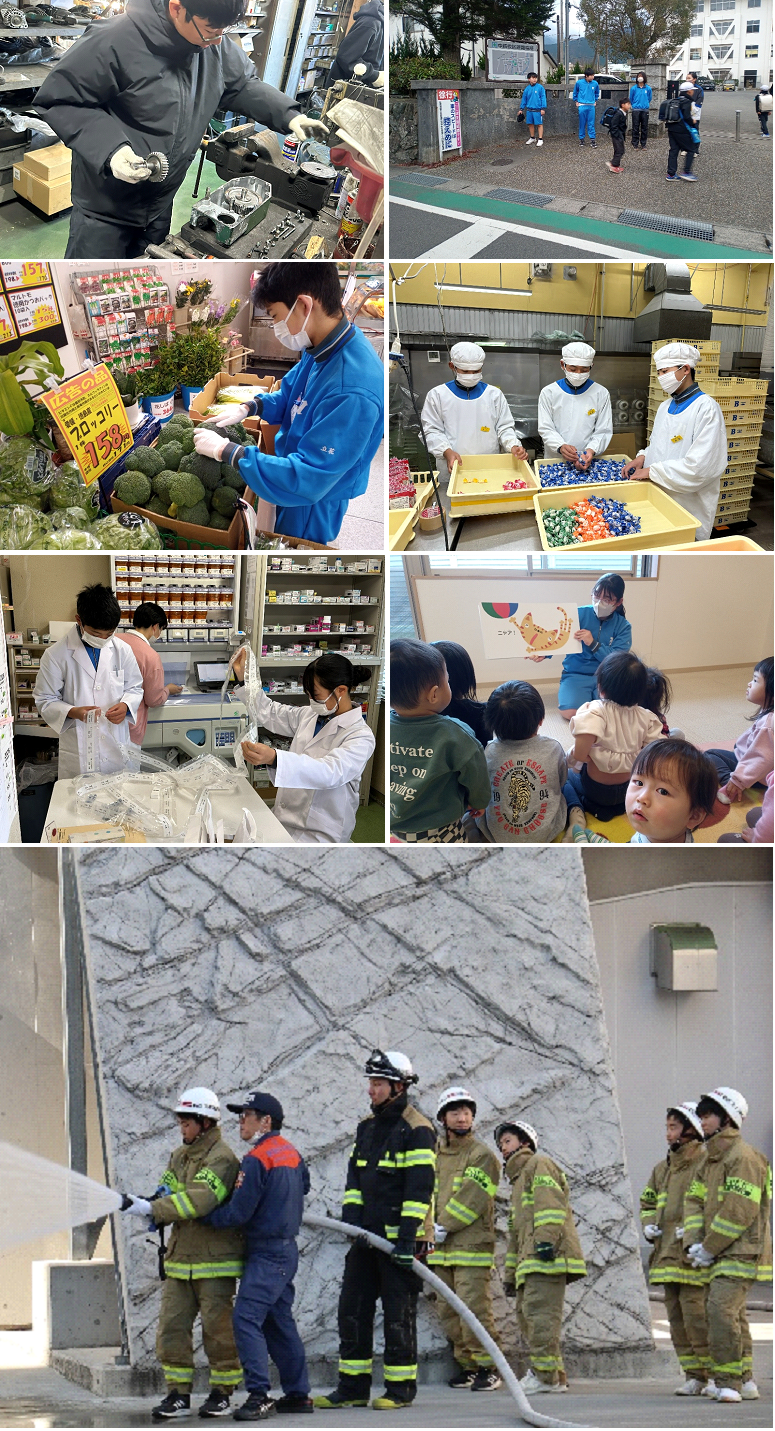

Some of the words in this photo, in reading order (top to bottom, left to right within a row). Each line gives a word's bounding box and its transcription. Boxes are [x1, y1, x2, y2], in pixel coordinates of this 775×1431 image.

[22, 262, 43, 276] 157
[11, 291, 32, 301] マルトモ
[39, 314, 54, 324] 300
[48, 370, 108, 410] 広告の品
[70, 403, 119, 441] ブロッコリー
[84, 424, 123, 468] 158
[412, 767, 427, 779] on
[493, 759, 514, 787] CREATE
[526, 759, 547, 785] ESCAPE
